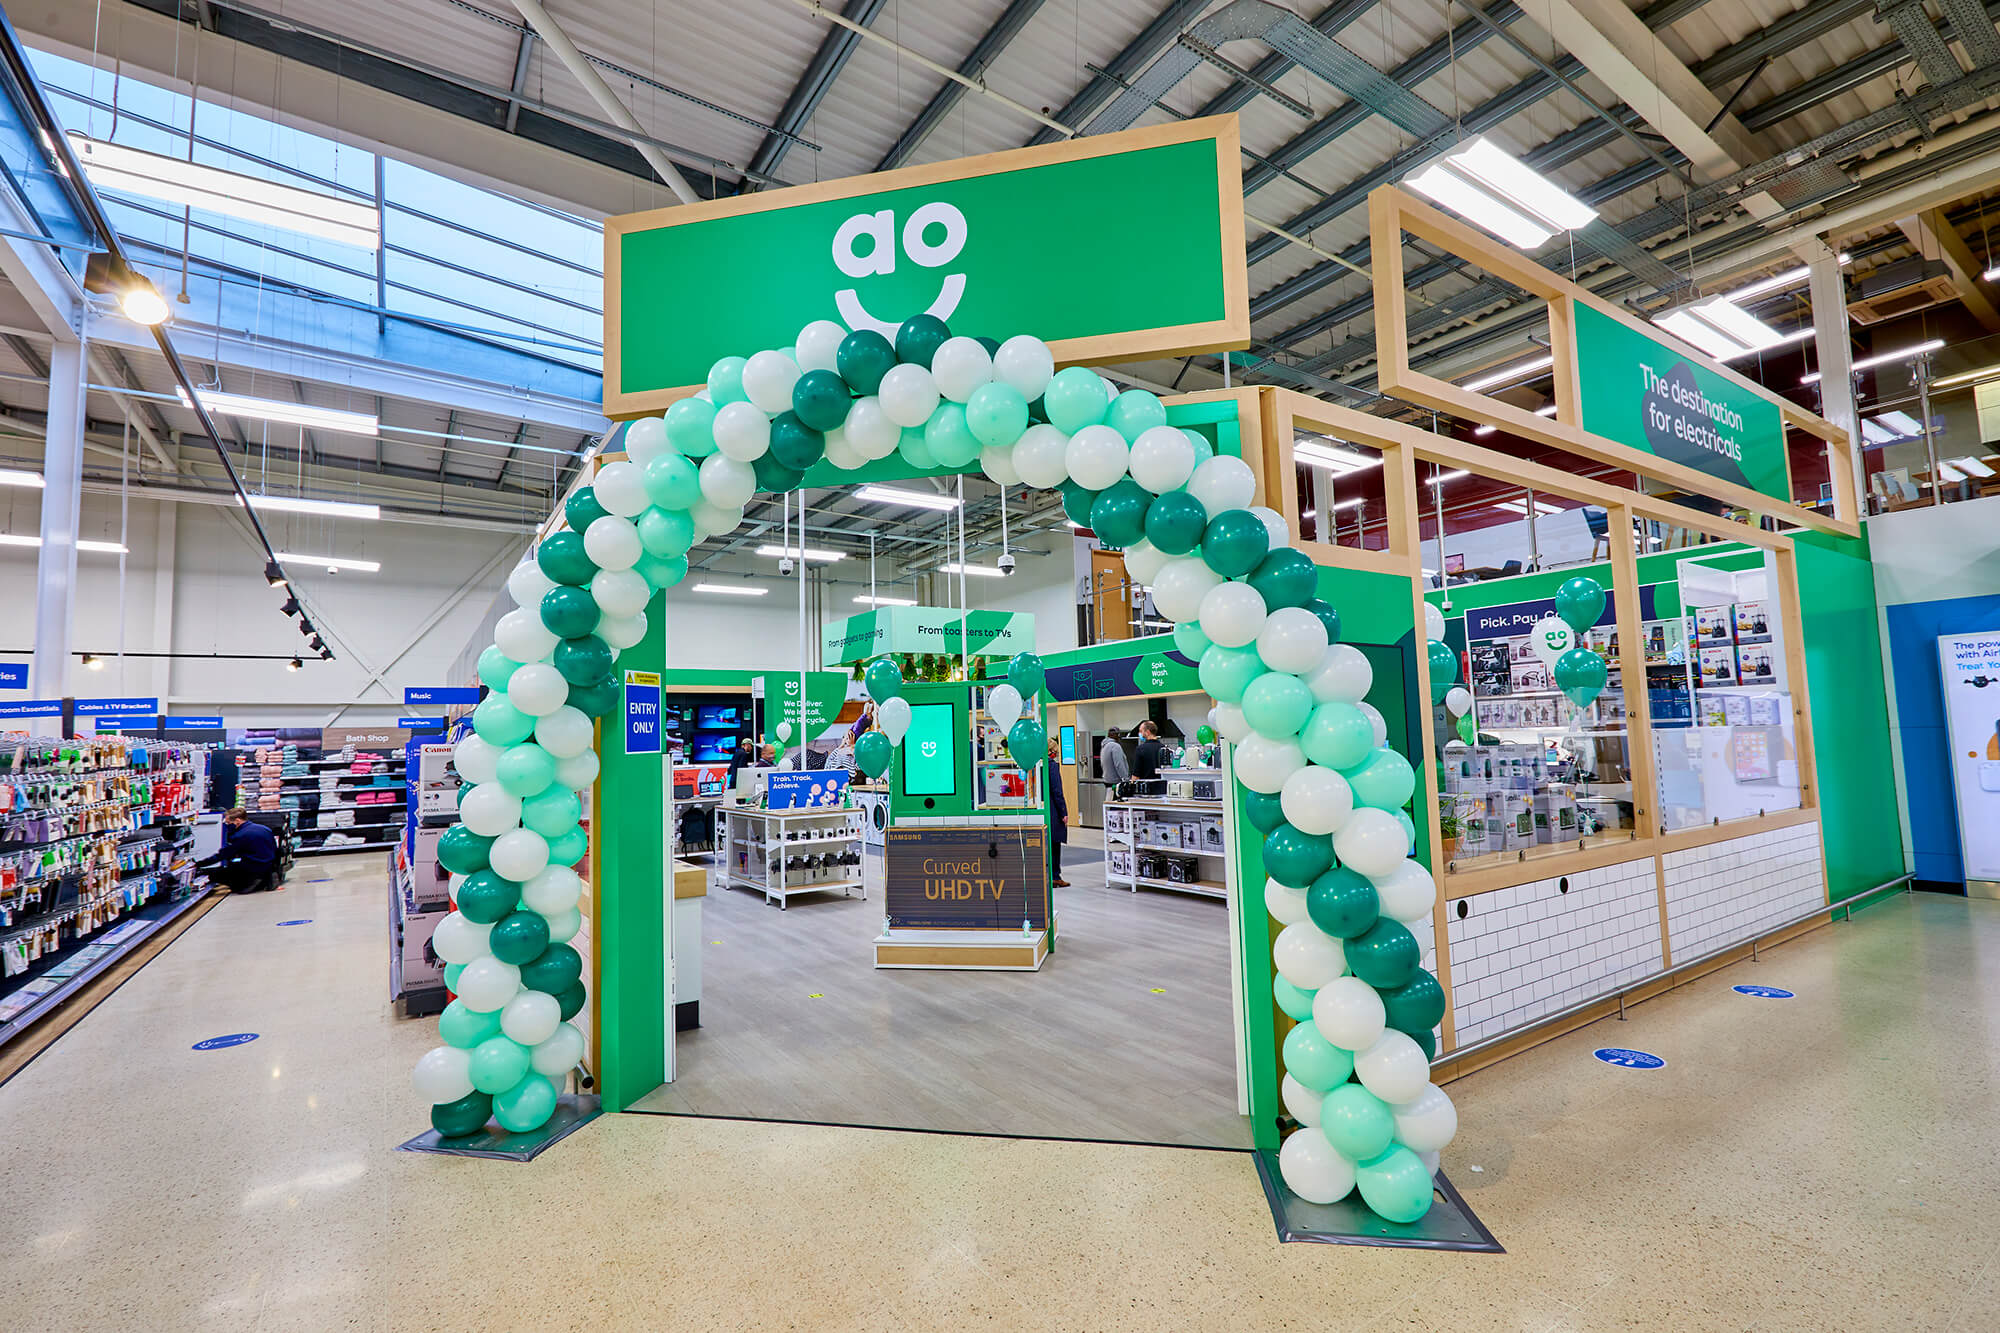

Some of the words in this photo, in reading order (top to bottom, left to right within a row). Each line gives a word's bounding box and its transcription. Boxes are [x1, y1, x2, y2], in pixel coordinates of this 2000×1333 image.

[832, 202, 967, 278] ao
[1640, 363, 1669, 398] The
[1671, 380, 1743, 432] destination
[1649, 402, 1671, 432] for
[1674, 416, 1742, 461] electricals
[1480, 617, 1510, 629] Pick.
[918, 626, 943, 635] From
[944, 626, 982, 636] toaters
[984, 629, 994, 637] to
[995, 629, 1012, 638] TVs
[1545, 631, 1567, 640] ao
[1954, 642, 1974, 650] The
[1956, 651, 1980, 659] with
[1956, 663, 1984, 671] Treat
[410, 692, 432, 700] Music
[630, 702, 657, 715] ENTRY
[797, 717, 828, 726] Rcycle.
[633, 721, 654, 734] ONLY
[368, 734, 389, 743] Shop
[921, 741, 937, 750] ao
[889, 833, 922, 841] SAMSUNG
[923, 856, 981, 875] Curved
